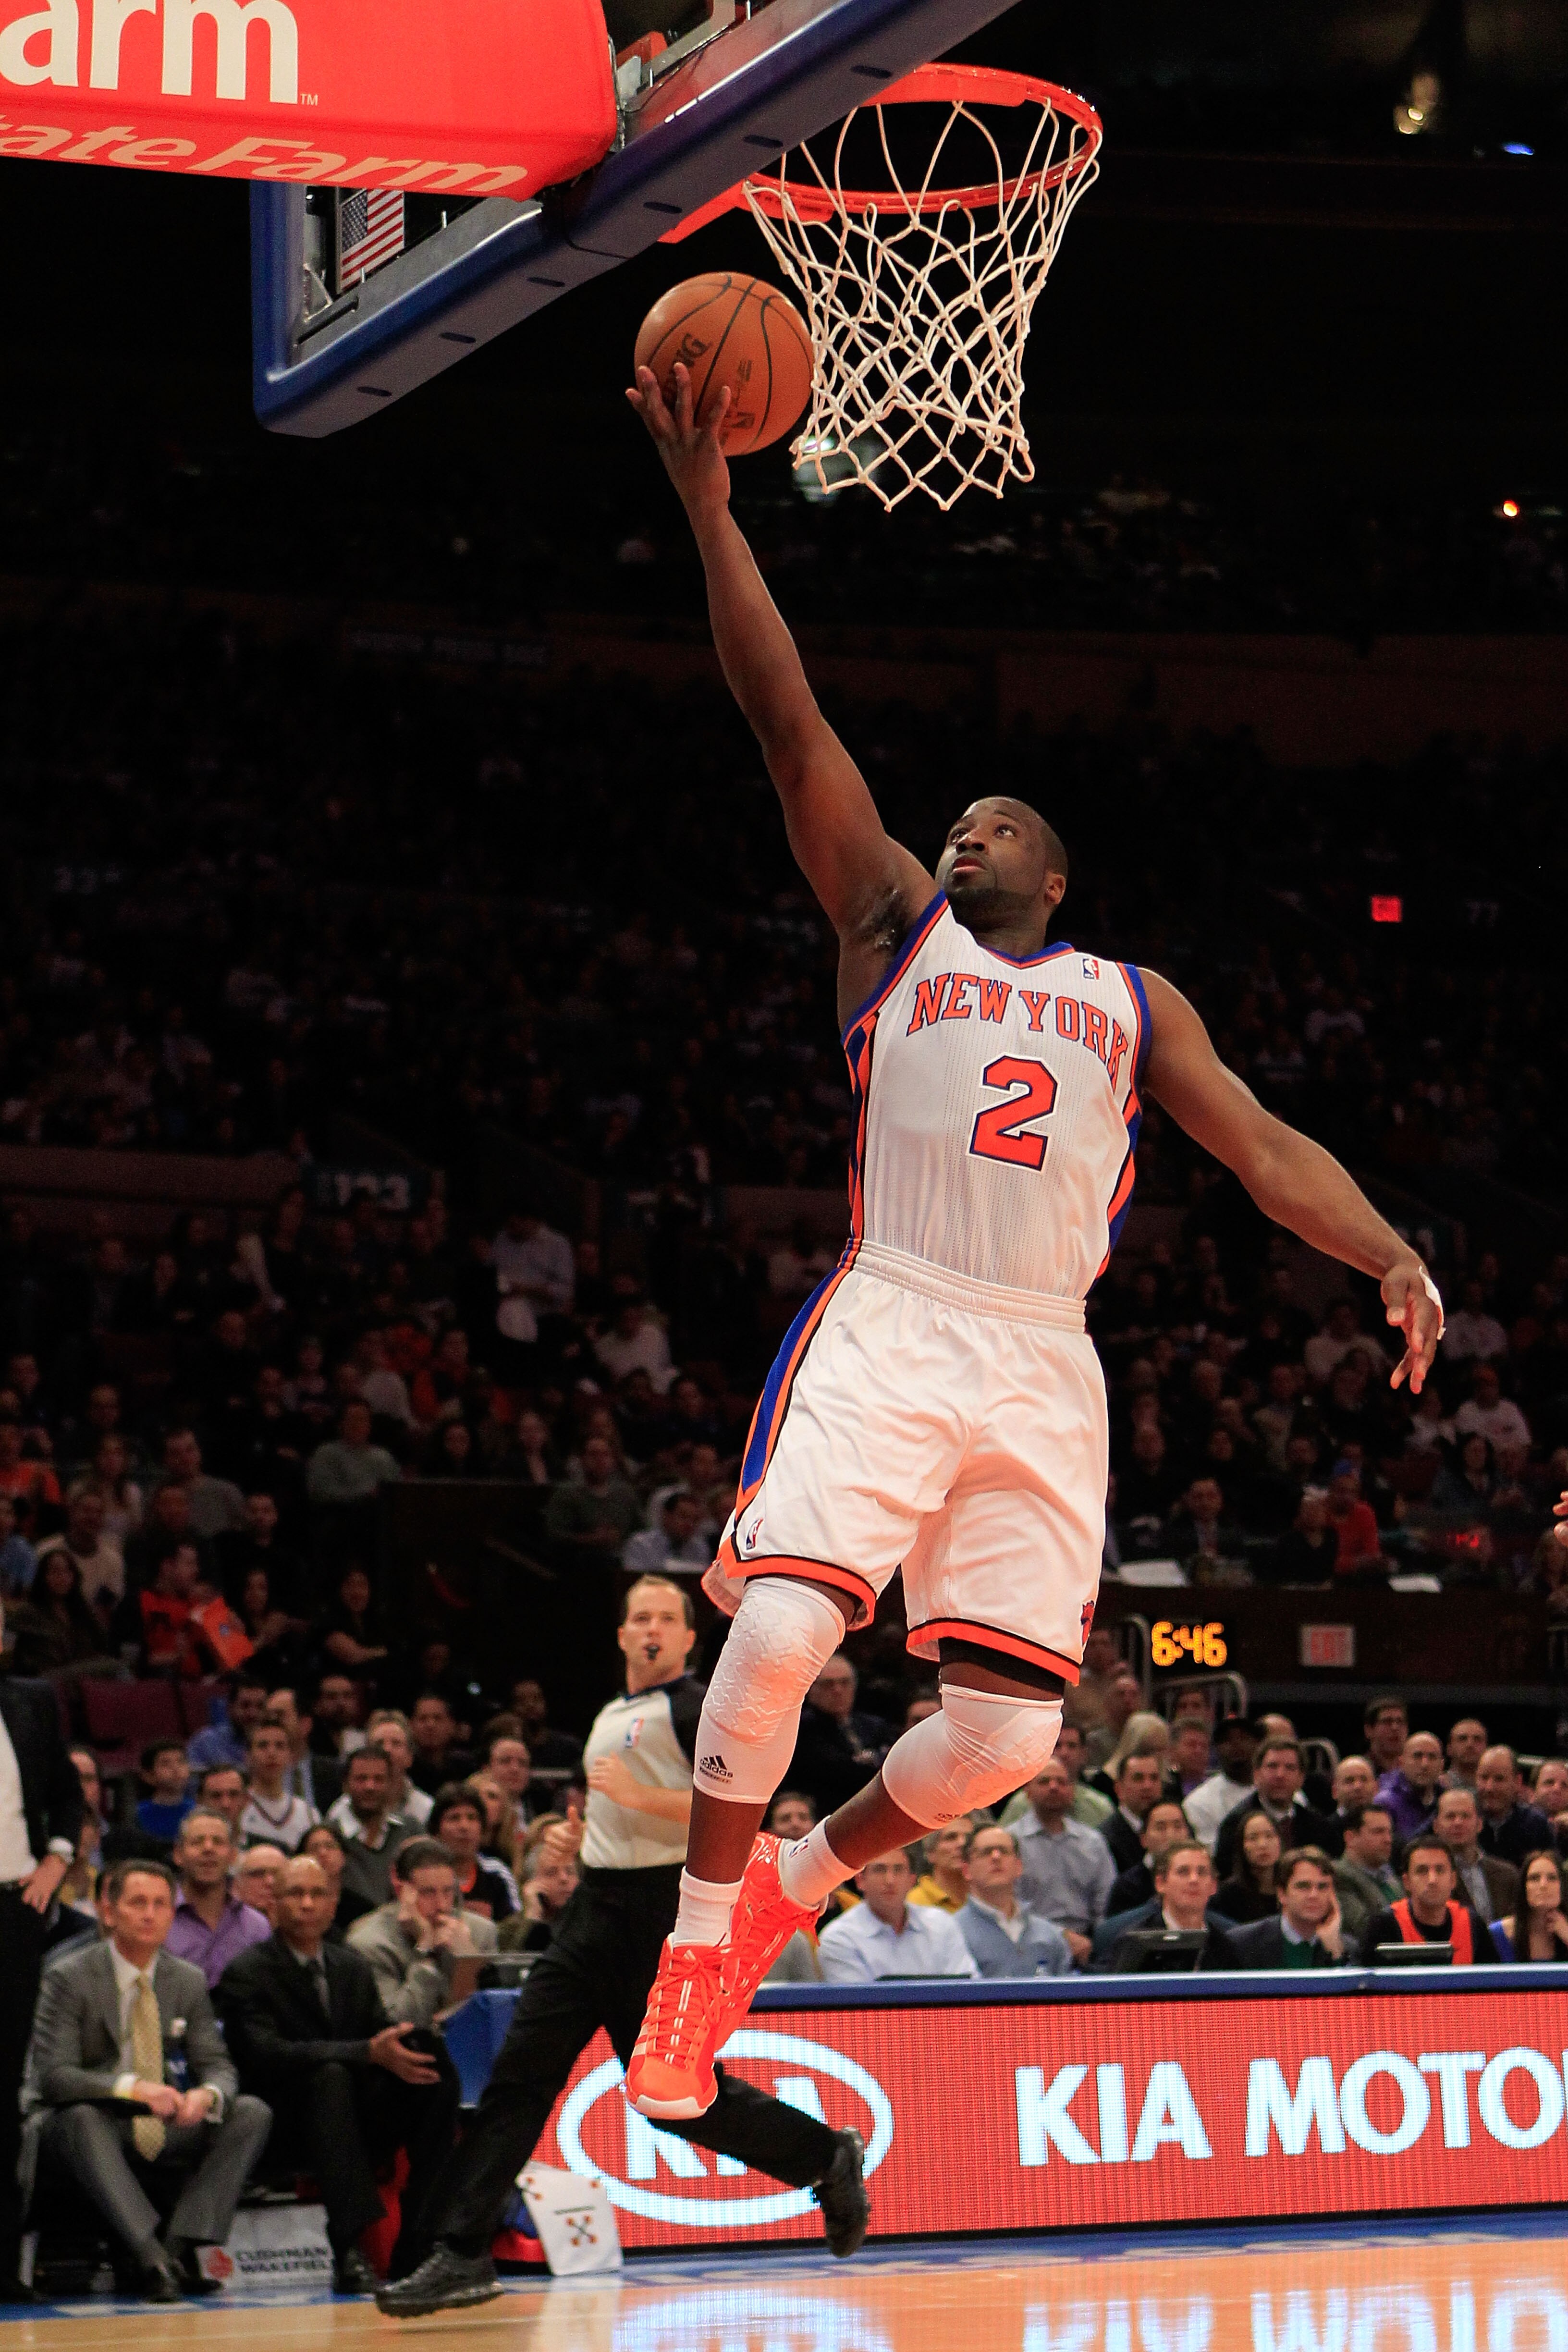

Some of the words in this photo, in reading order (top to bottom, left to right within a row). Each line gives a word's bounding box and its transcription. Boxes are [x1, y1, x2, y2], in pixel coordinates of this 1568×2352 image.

[0, 113, 196, 166] ate
[186, 137, 528, 192] Farm
[906, 973, 1012, 1036] NEW
[1018, 990, 1129, 1094] YORK
[969, 1055, 1058, 1172] 2
[1152, 1621, 1227, 1666] 6:46
[700, 1759, 733, 1778] adidas
[1015, 2061, 1213, 2166] KIA
[1244, 2046, 1568, 2157] MOTO
